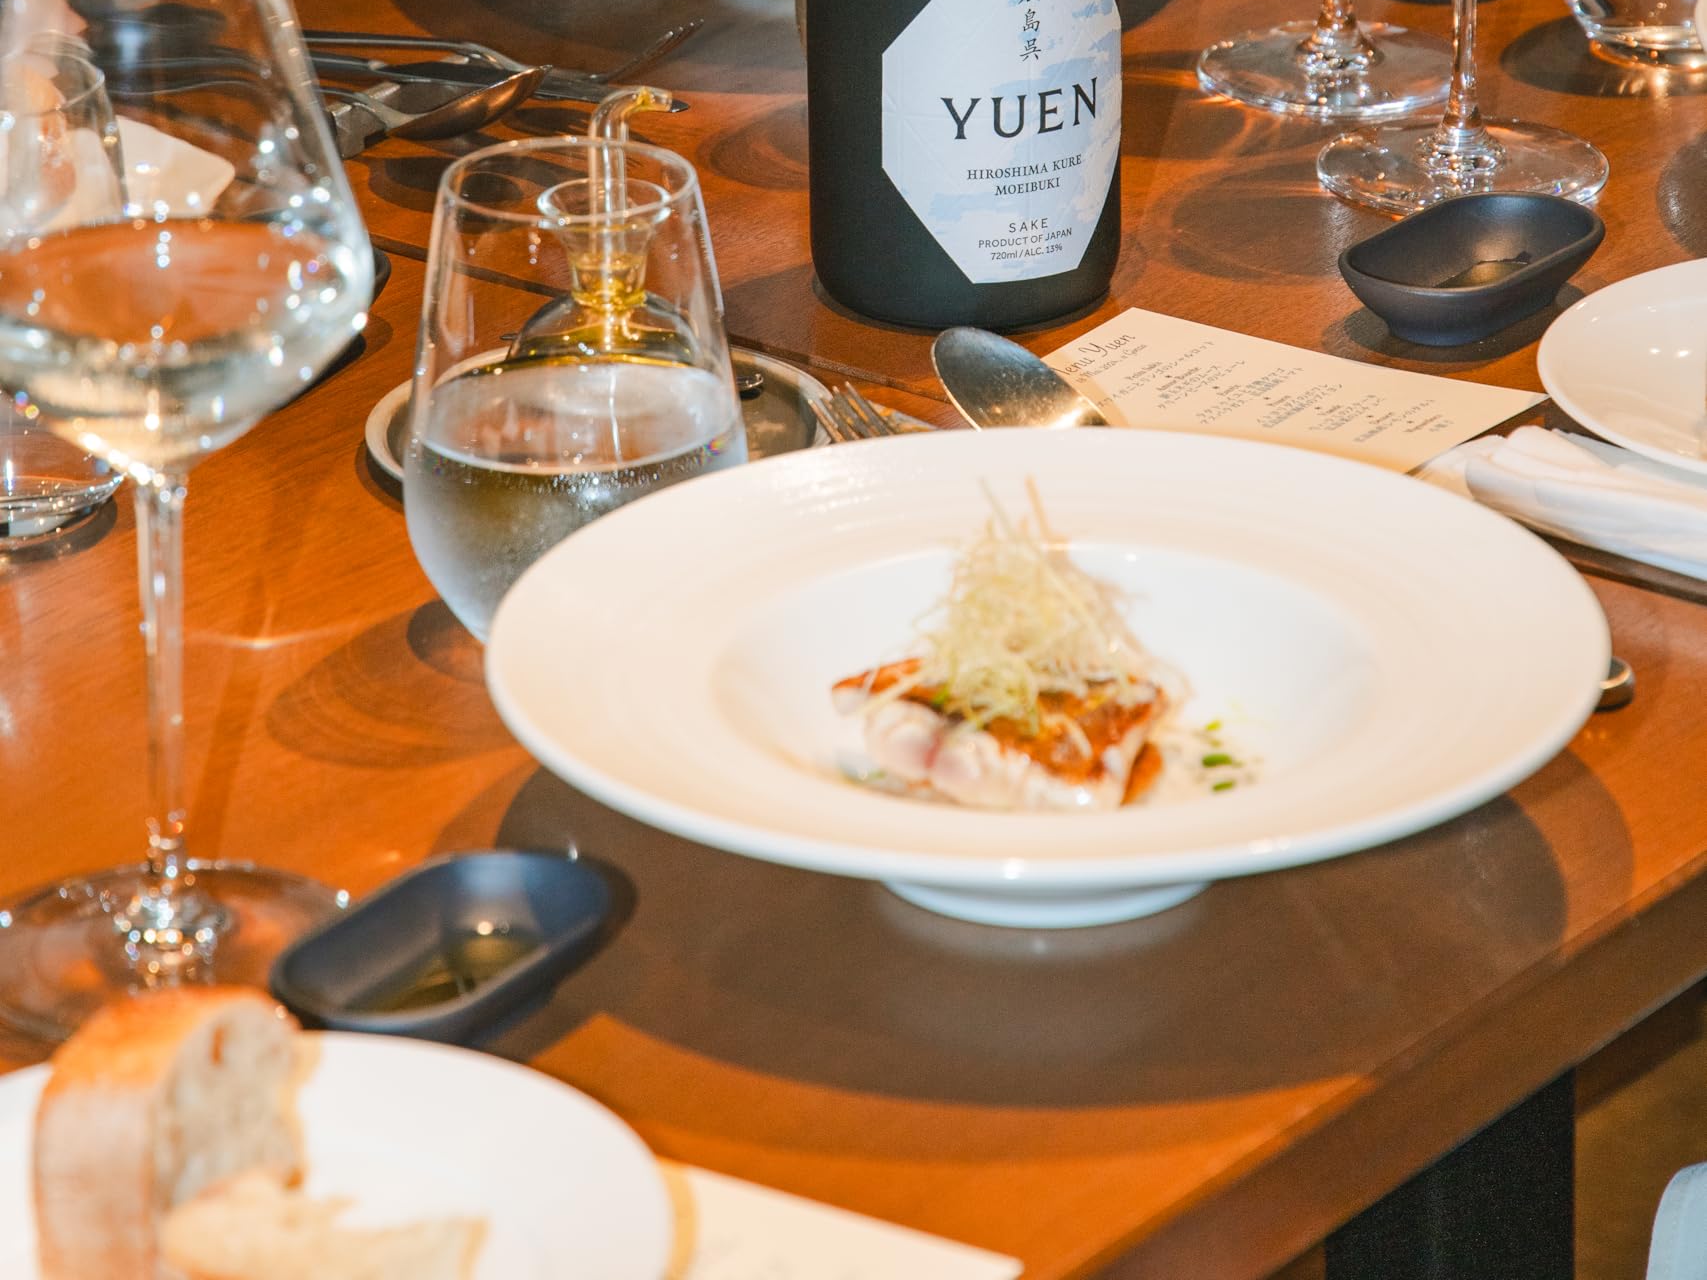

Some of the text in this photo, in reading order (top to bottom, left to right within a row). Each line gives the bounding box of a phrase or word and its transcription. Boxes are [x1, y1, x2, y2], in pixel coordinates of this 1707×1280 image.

[940, 77, 1098, 140] YUEN
[967, 154, 1082, 181] HIROSHIMA KURE
[994, 177, 1061, 196] MOEIBUKI
[1009, 218, 1049, 233] SAKE
[978, 227, 1072, 249] PRODUCT OF JAPAN
[1046, 243, 1063, 254] 13%
[1078, 334, 1136, 358] Yuen
